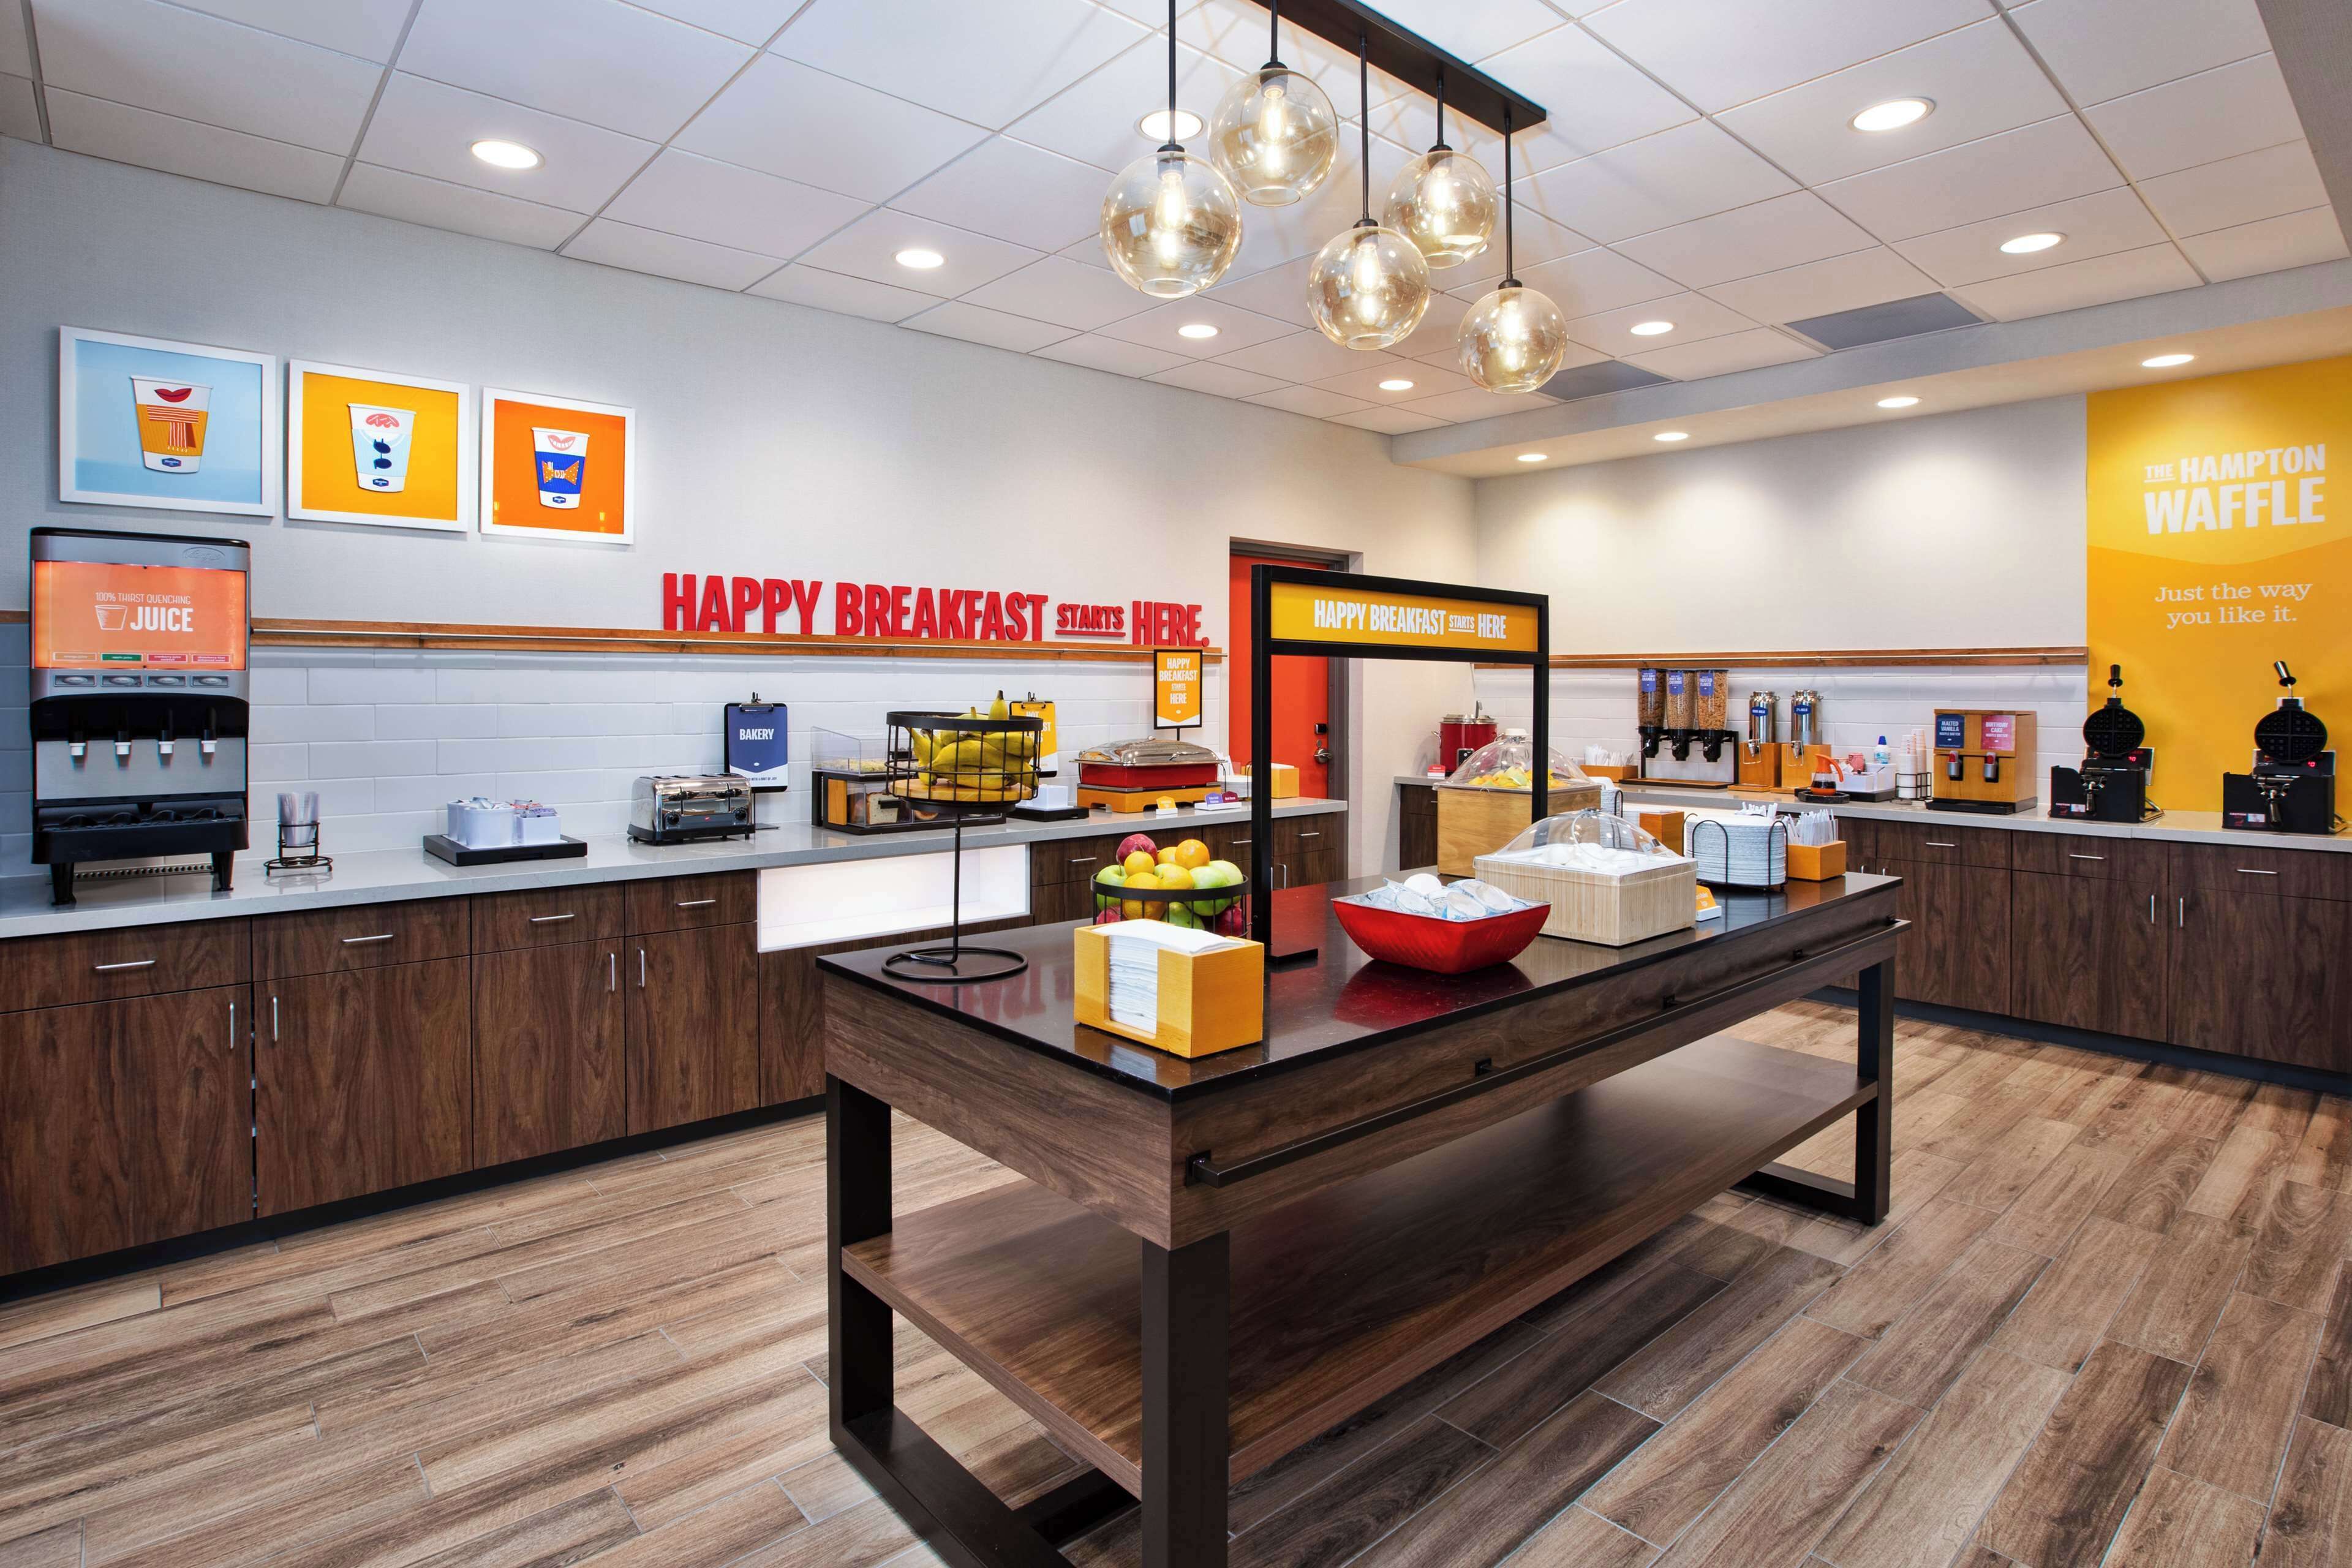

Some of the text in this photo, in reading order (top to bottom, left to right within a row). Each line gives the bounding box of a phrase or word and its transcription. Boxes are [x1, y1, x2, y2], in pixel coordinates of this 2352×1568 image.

[2144, 443, 2326, 484] THE HAMPTON
[2144, 477, 2326, 535] WAFFLE
[96, 592, 191, 605] 100% THIRST QUENCHING
[2155, 582, 2313, 602] Just the way
[130, 606, 194, 632] JUICE
[663, 573, 1210, 647] HAPPY BREAKFAST STARTS HERE.
[1314, 599, 1507, 639] HAPPY BREAKFAST STARTS HERE
[2167, 605, 2297, 629] you like it.
[1166, 658, 1190, 669] HAPPY
[1159, 670, 1197, 681] BREAKFAST
[1170, 693, 1187, 704] HERE
[739, 728, 775, 740] BAKERY
